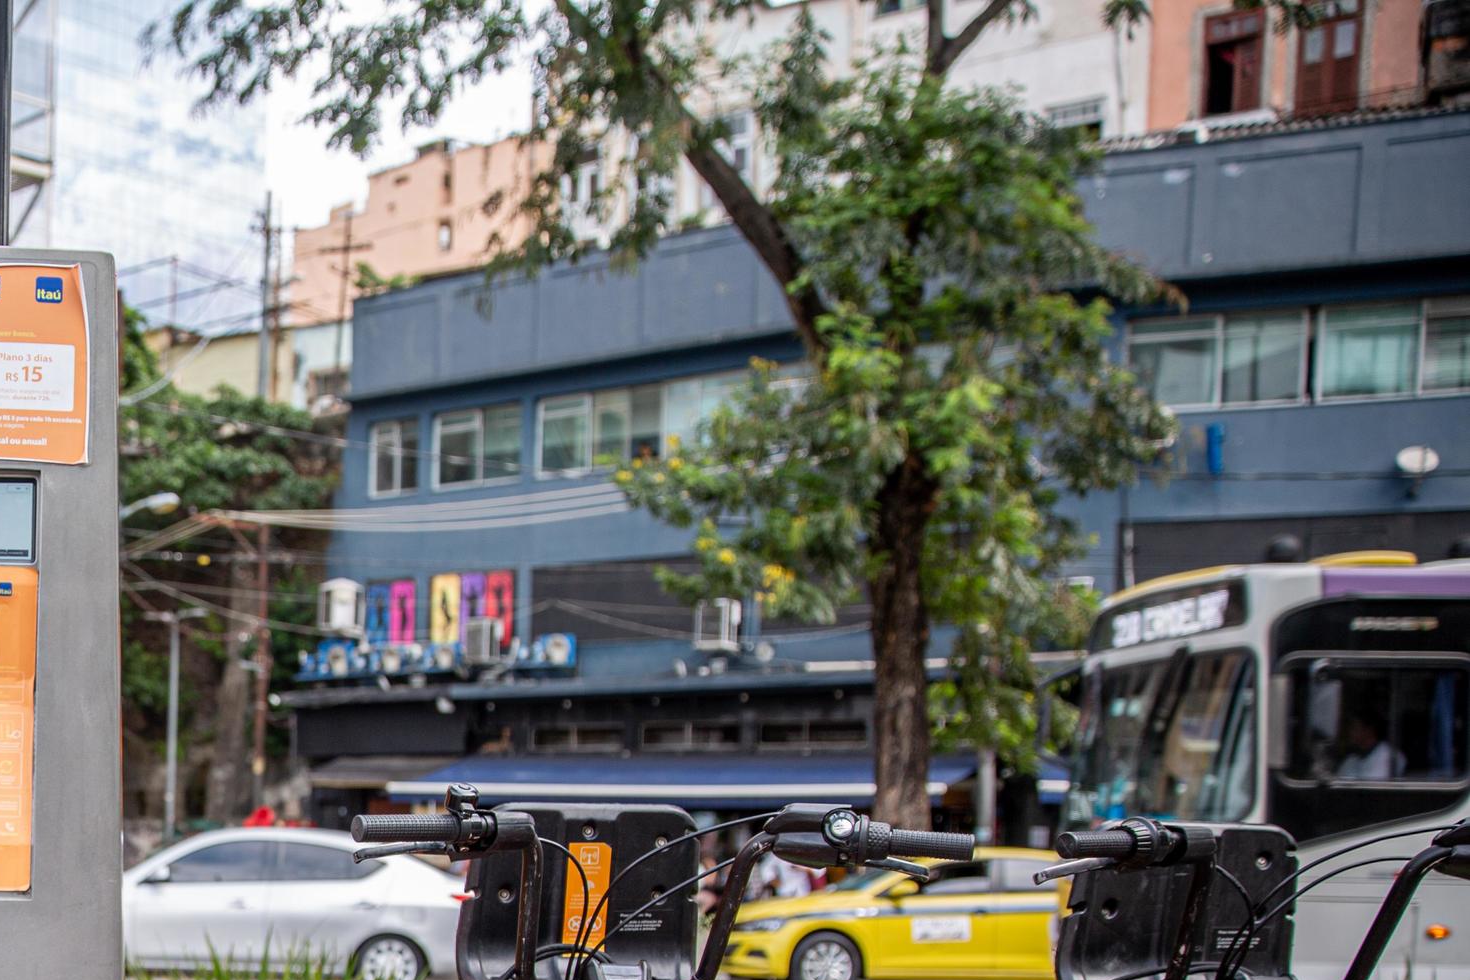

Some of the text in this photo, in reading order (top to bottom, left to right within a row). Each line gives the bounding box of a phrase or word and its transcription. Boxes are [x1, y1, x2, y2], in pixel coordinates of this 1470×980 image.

[37, 288, 61, 300] Itaú
[26, 354, 32, 362] 3
[34, 353, 53, 363] dias
[5, 366, 43, 382] R$ 15
